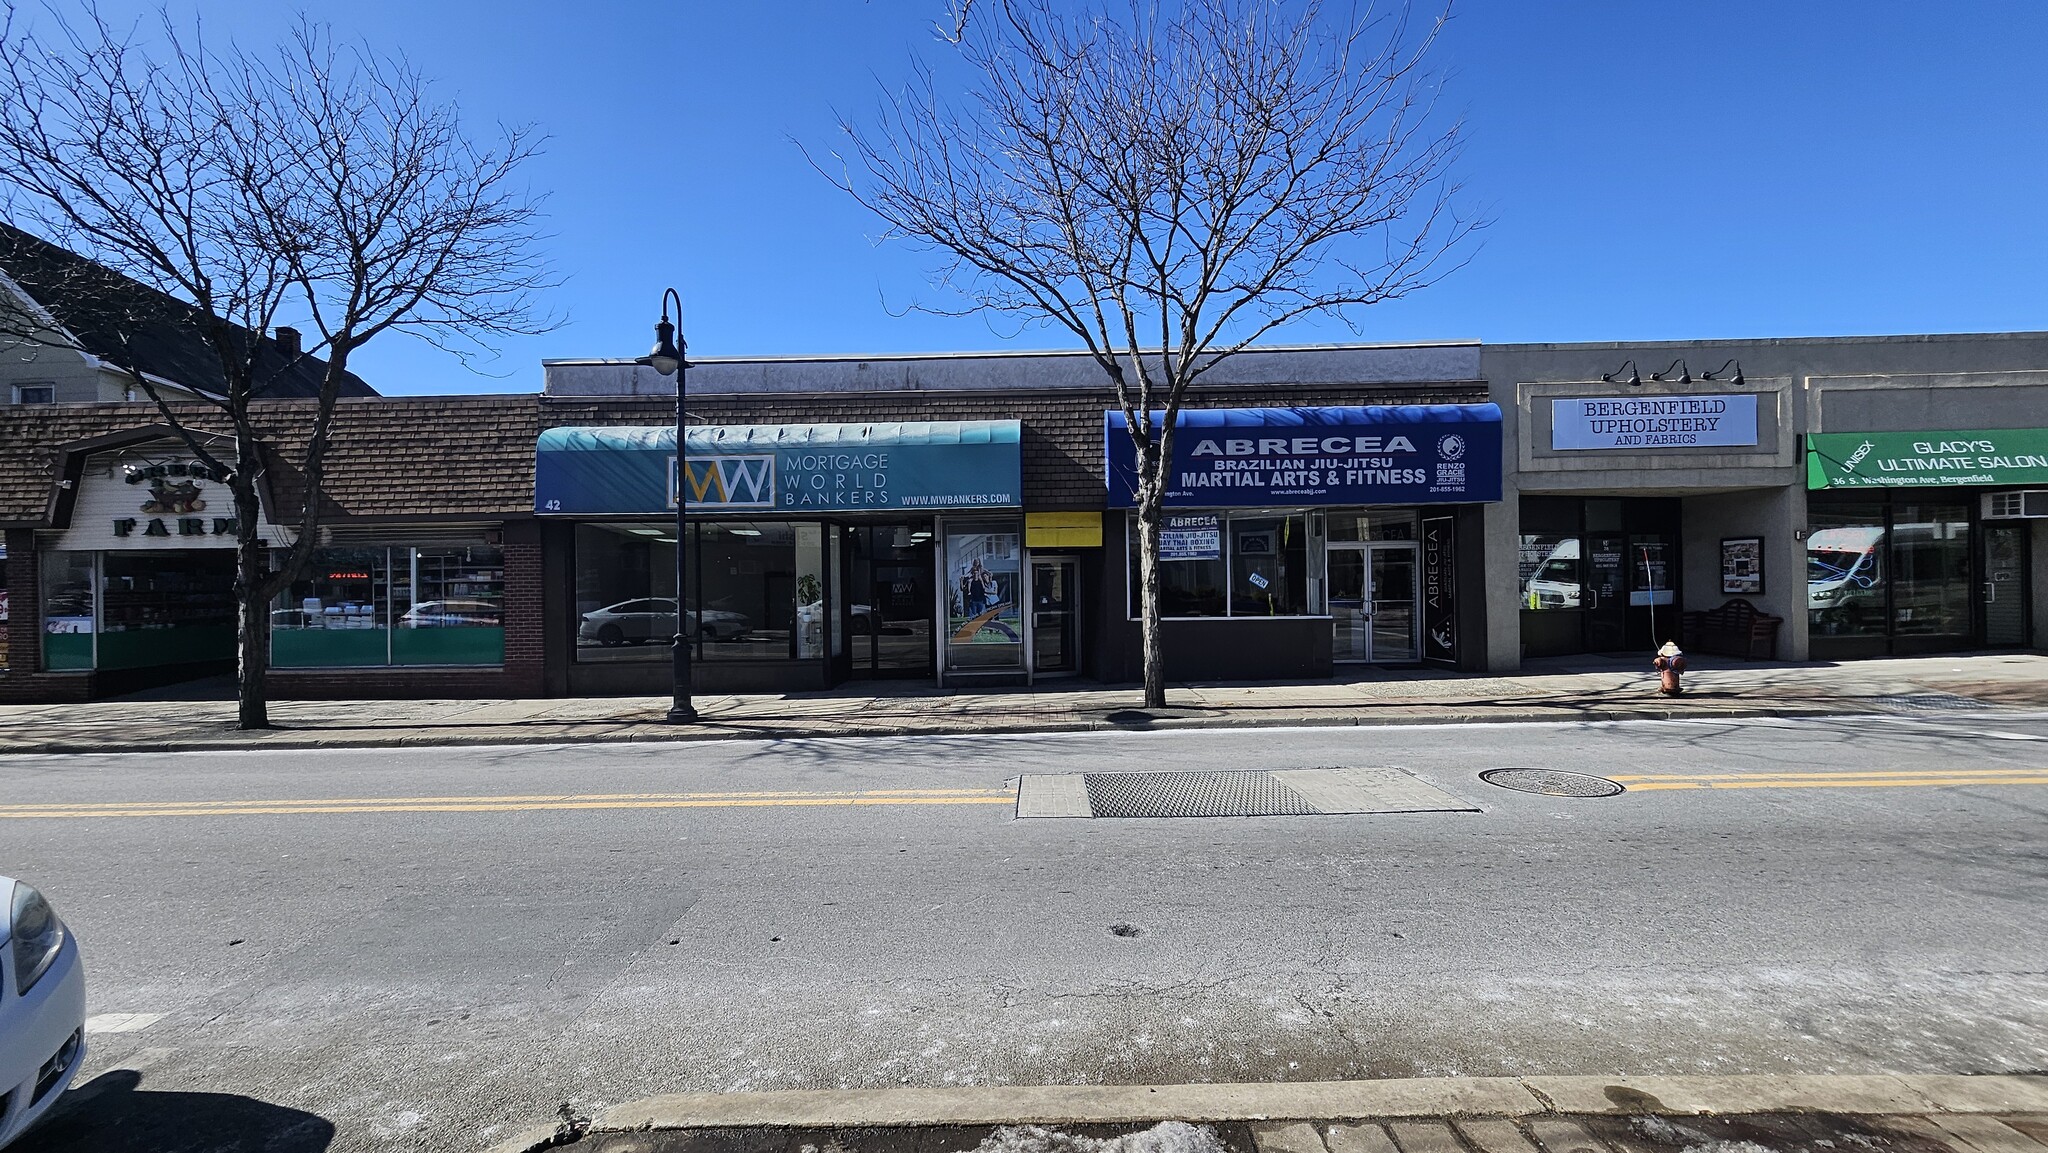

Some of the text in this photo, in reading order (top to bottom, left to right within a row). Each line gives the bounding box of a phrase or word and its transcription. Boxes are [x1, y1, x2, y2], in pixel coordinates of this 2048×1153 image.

[1584, 399, 1726, 417] BERGENFIELD
[1590, 417, 1721, 434] UPHOLSTERY
[1191, 436, 1418, 456] ABRECEA
[1614, 433, 1697, 446] AND FABRICS
[1913, 440, 1996, 455] GLACY'S
[786, 453, 888, 471] MORTGAGE
[1214, 457, 1393, 471] BRAZILIAN JIU-JITSU
[1840, 439, 1876, 474] UNISEX
[1877, 455, 2048, 472] ULTIMATE SALON
[673, 458, 773, 504] MW
[785, 473, 887, 489] WORLD
[1182, 468, 1427, 488] MARTIAL ARTS & FITNESS
[1832, 474, 1994, 487] 36 S. Washington Ave, Bergenfield
[545, 499, 561, 511] 42
[785, 490, 889, 506] BANKERS
[901, 493, 1011, 506] WWW.MWBANKERS.COM
[112, 517, 240, 537] FARM
[1170, 516, 1218, 527] ABRECEA
[1159, 531, 1218, 540] AZILIAN JIU-JITSU
[1190, 538, 1215, 546] BOXING
[1427, 529, 1439, 609] ABRECEA
[1251, 575, 1266, 587] OPEN
